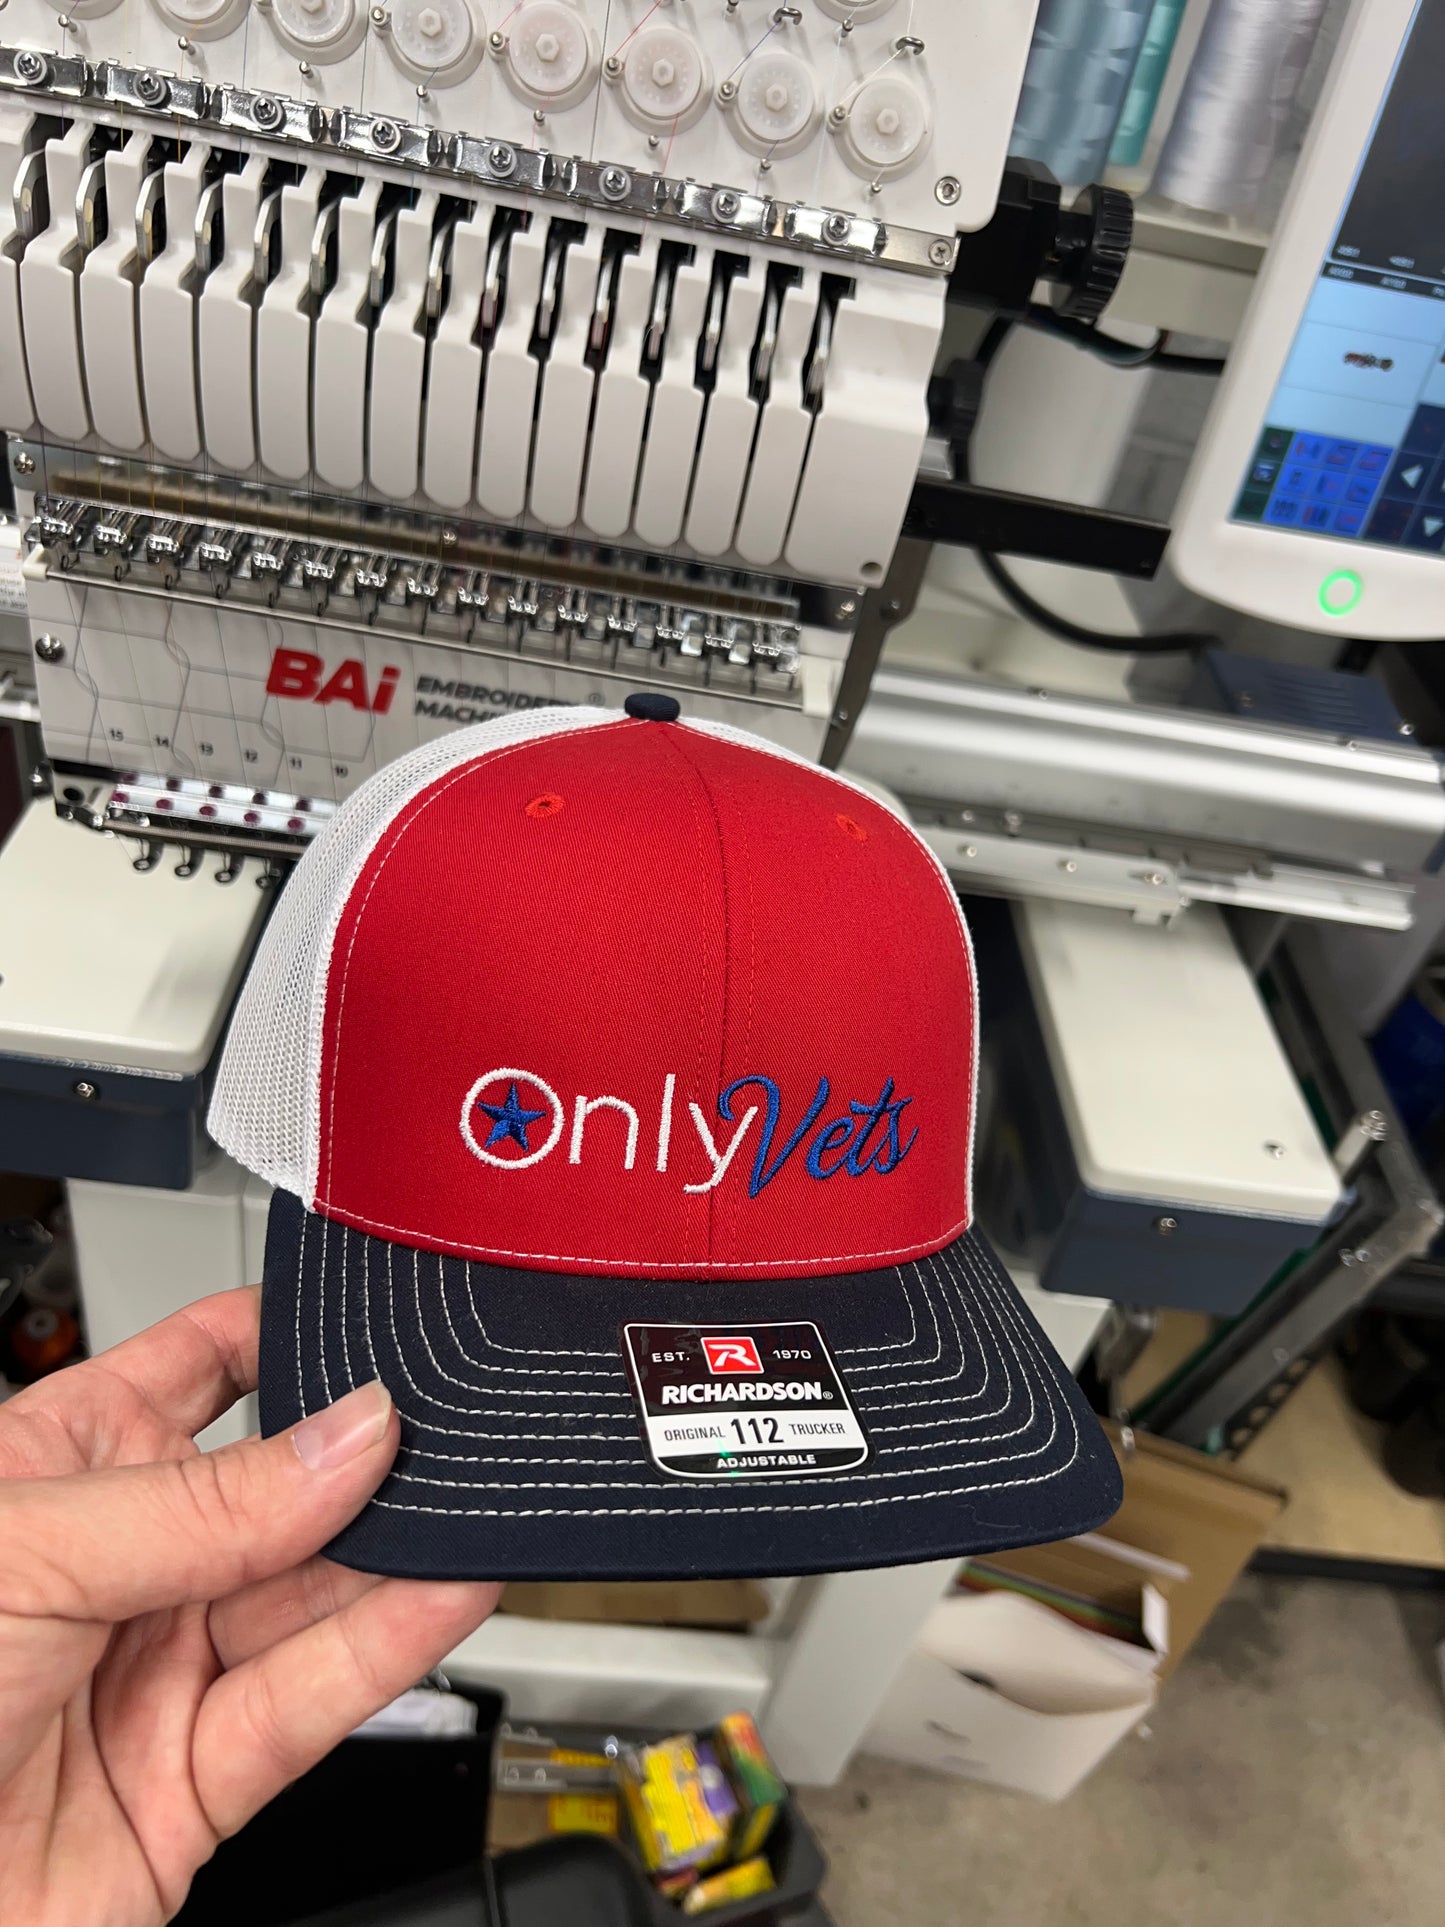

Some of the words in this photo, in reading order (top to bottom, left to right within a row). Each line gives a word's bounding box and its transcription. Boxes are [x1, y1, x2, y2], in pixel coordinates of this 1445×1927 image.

[417, 675, 579, 709] EMBROIDE
[110, 729, 124, 741] 15
[156, 736, 169, 748] 14
[199, 743, 214, 756] 13
[245, 751, 258, 763] 12
[290, 758, 302, 770] 11
[335, 766, 349, 778] 10
[652, 1351, 690, 1363] EST.
[773, 1349, 812, 1360] 1970
[664, 1426, 726, 1441] ORIGINAL
[731, 1417, 784, 1445] 112
[789, 1423, 846, 1435] TRUCKER
[716, 1453, 817, 1469] ADJUSTABLE
